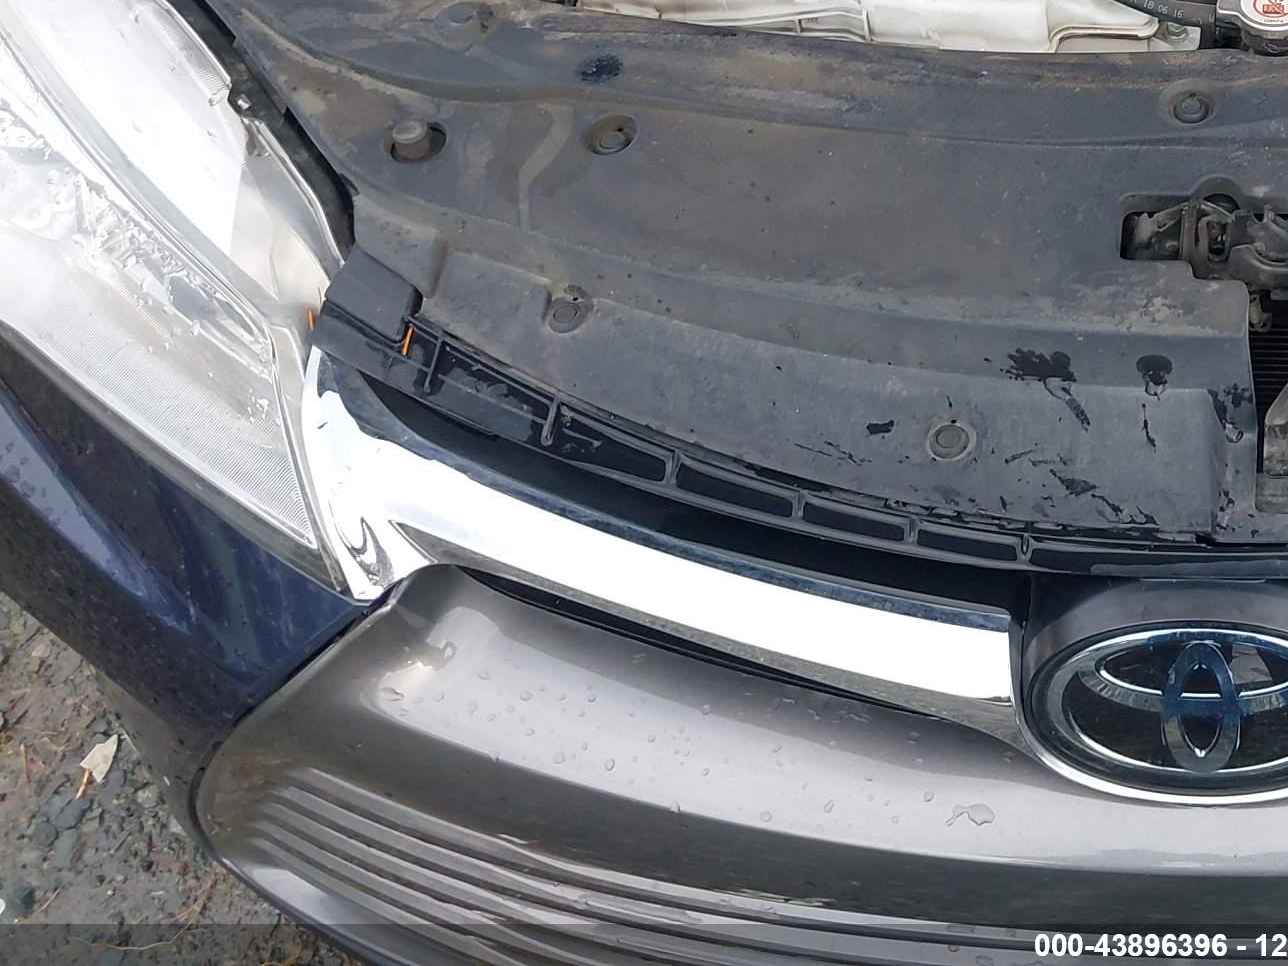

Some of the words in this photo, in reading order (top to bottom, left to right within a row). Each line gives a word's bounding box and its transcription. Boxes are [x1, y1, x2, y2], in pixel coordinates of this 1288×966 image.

[1143, 0, 1155, 10] 18
[1158, 4, 1169, 14] 06
[1174, 9, 1184, 18] 16
